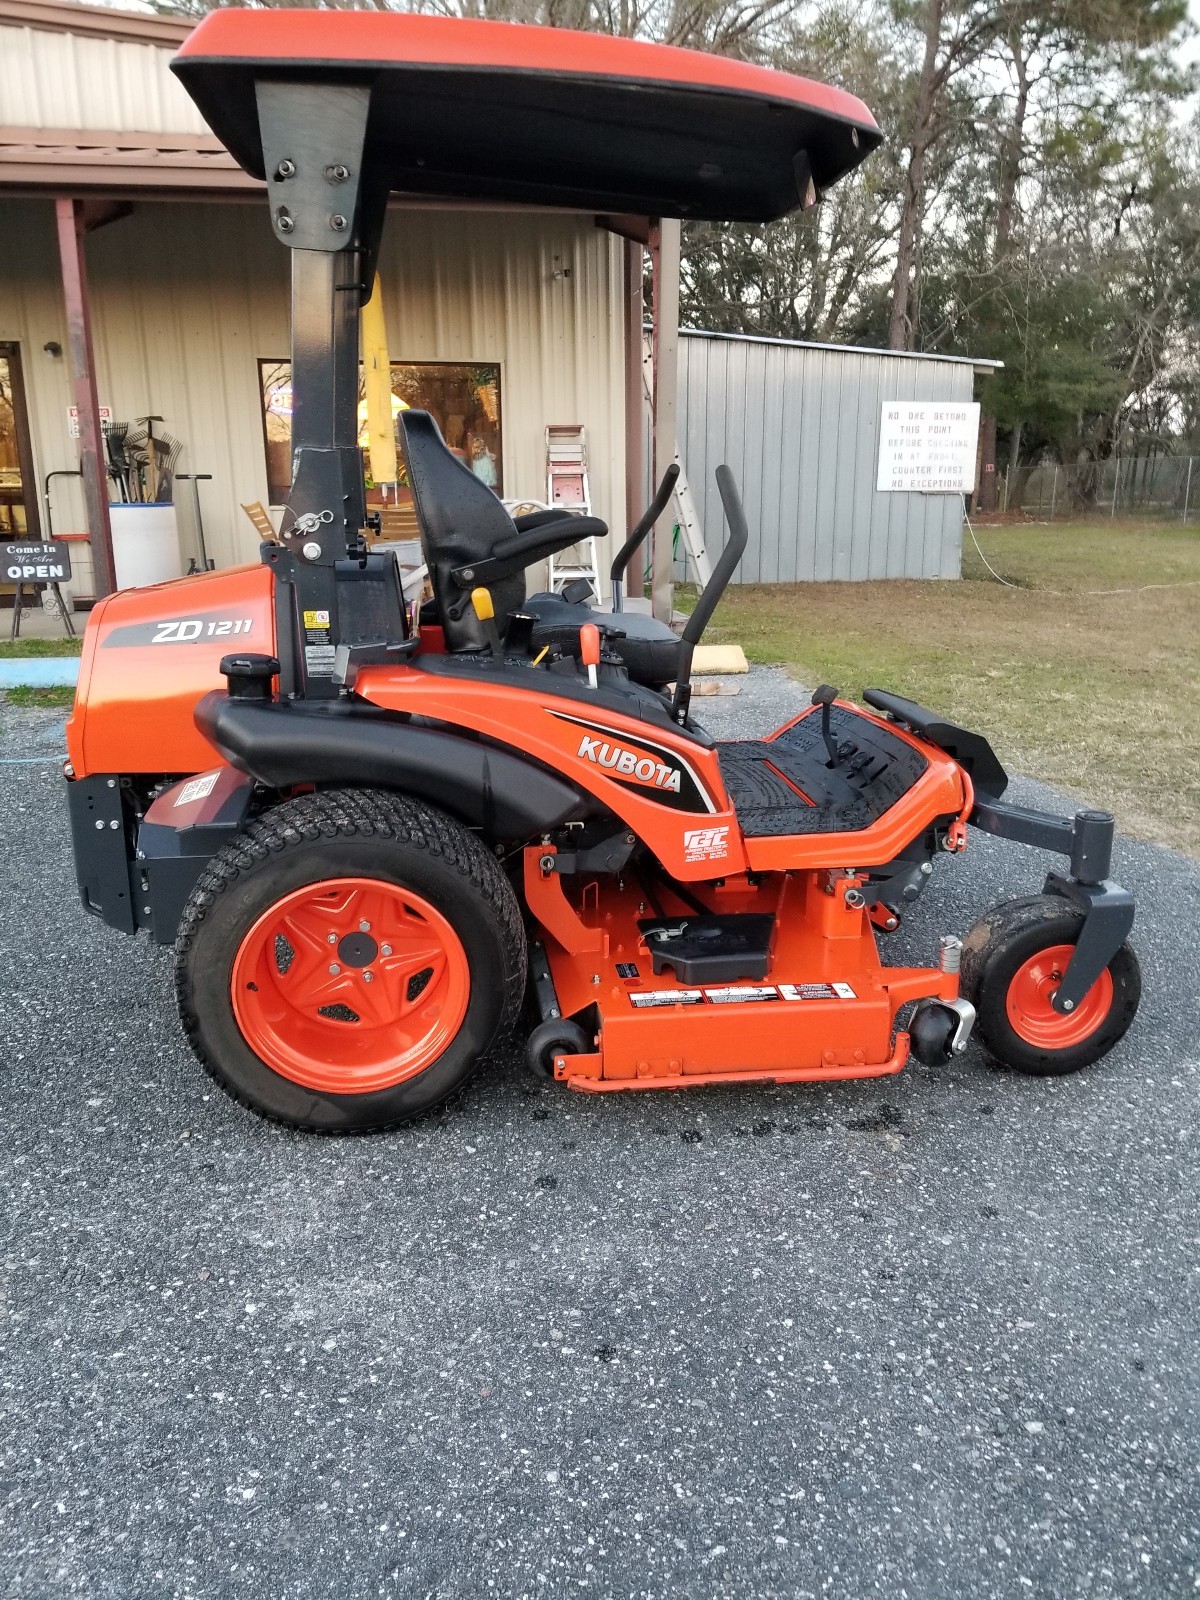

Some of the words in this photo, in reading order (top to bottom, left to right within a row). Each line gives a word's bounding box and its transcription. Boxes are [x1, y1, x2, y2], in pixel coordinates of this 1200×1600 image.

[271, 395, 293, 407] OP
[888, 411, 899, 420] NO
[908, 412, 925, 420] ONE
[934, 412, 967, 421] BEYOND
[900, 425, 920, 434] THIS
[928, 425, 952, 434] POINT
[888, 439, 922, 447] BEFORE
[892, 466, 932, 475] COUNTER
[938, 466, 963, 474] FIRST
[891, 480, 903, 488] NO
[910, 479, 963, 488] EXCEPTIONS
[6, 545, 41, 554] Come
[43, 544, 57, 553] In
[15, 554, 30, 563] We
[32, 554, 53, 563] Are
[7, 564, 64, 579] OPEN
[152, 620, 203, 643] ZD
[207, 619, 253, 636] 1211
[577, 735, 681, 794] KUBOTA
